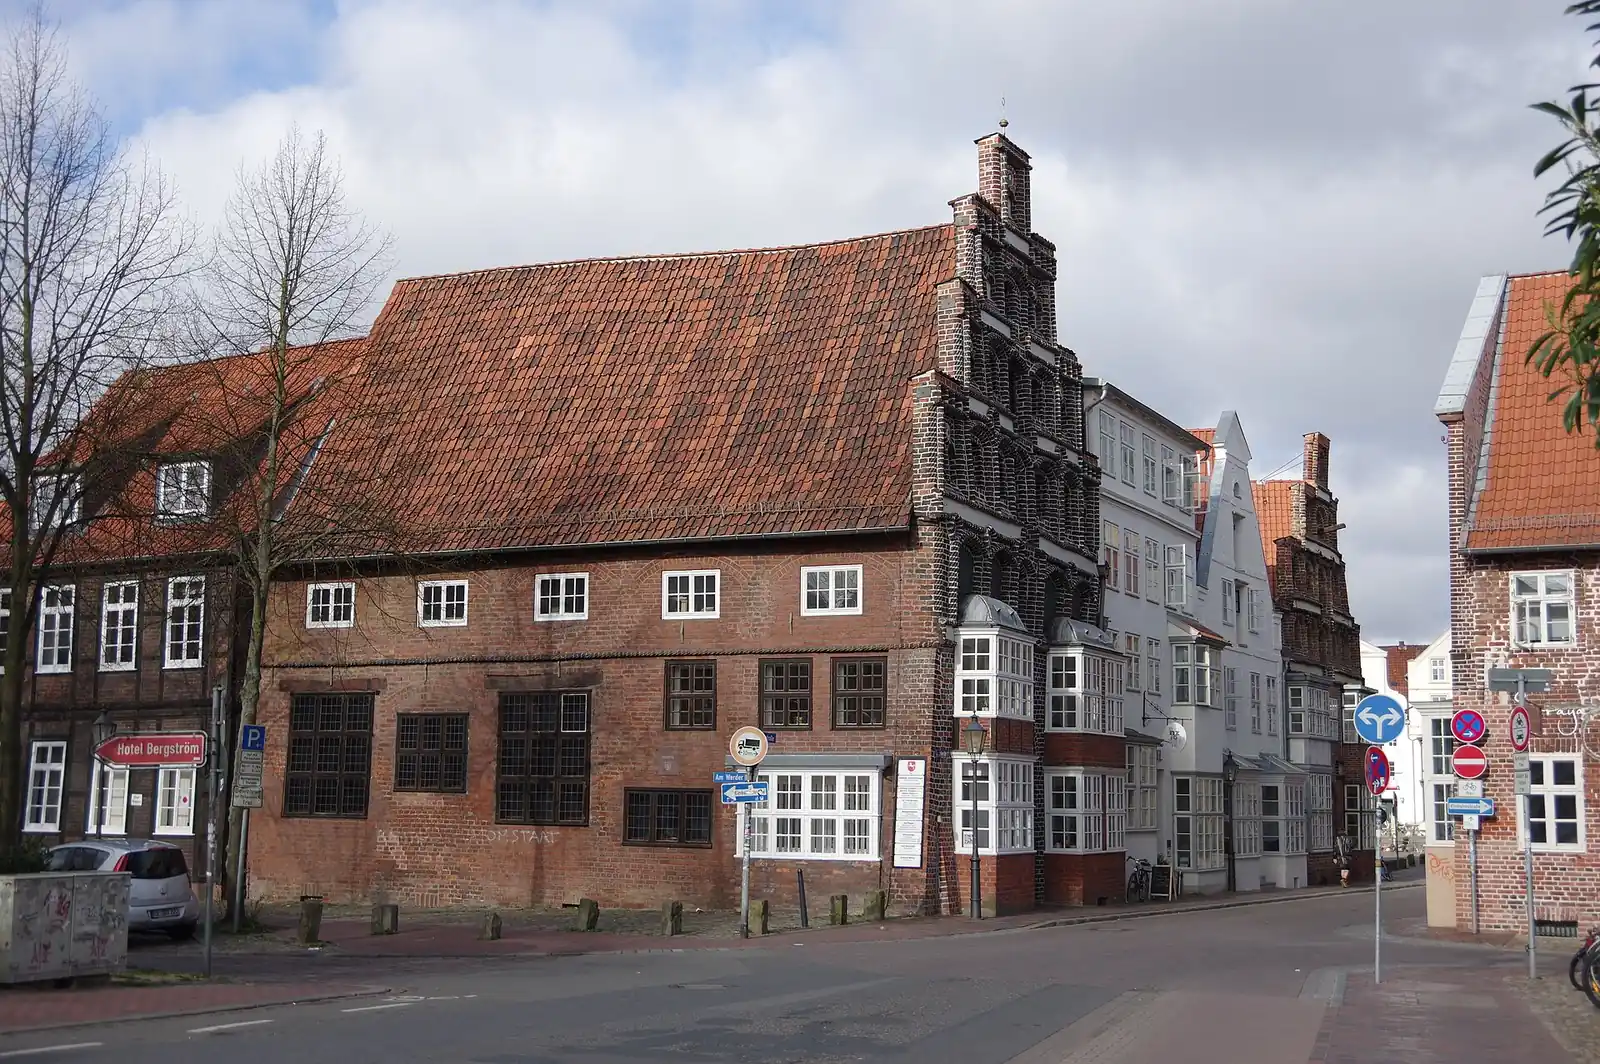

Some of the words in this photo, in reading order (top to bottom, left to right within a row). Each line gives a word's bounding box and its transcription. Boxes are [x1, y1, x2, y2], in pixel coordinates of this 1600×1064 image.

[248, 729, 260, 747] P
[117, 743, 144, 756] Hotel
[146, 741, 199, 757] Bergström
